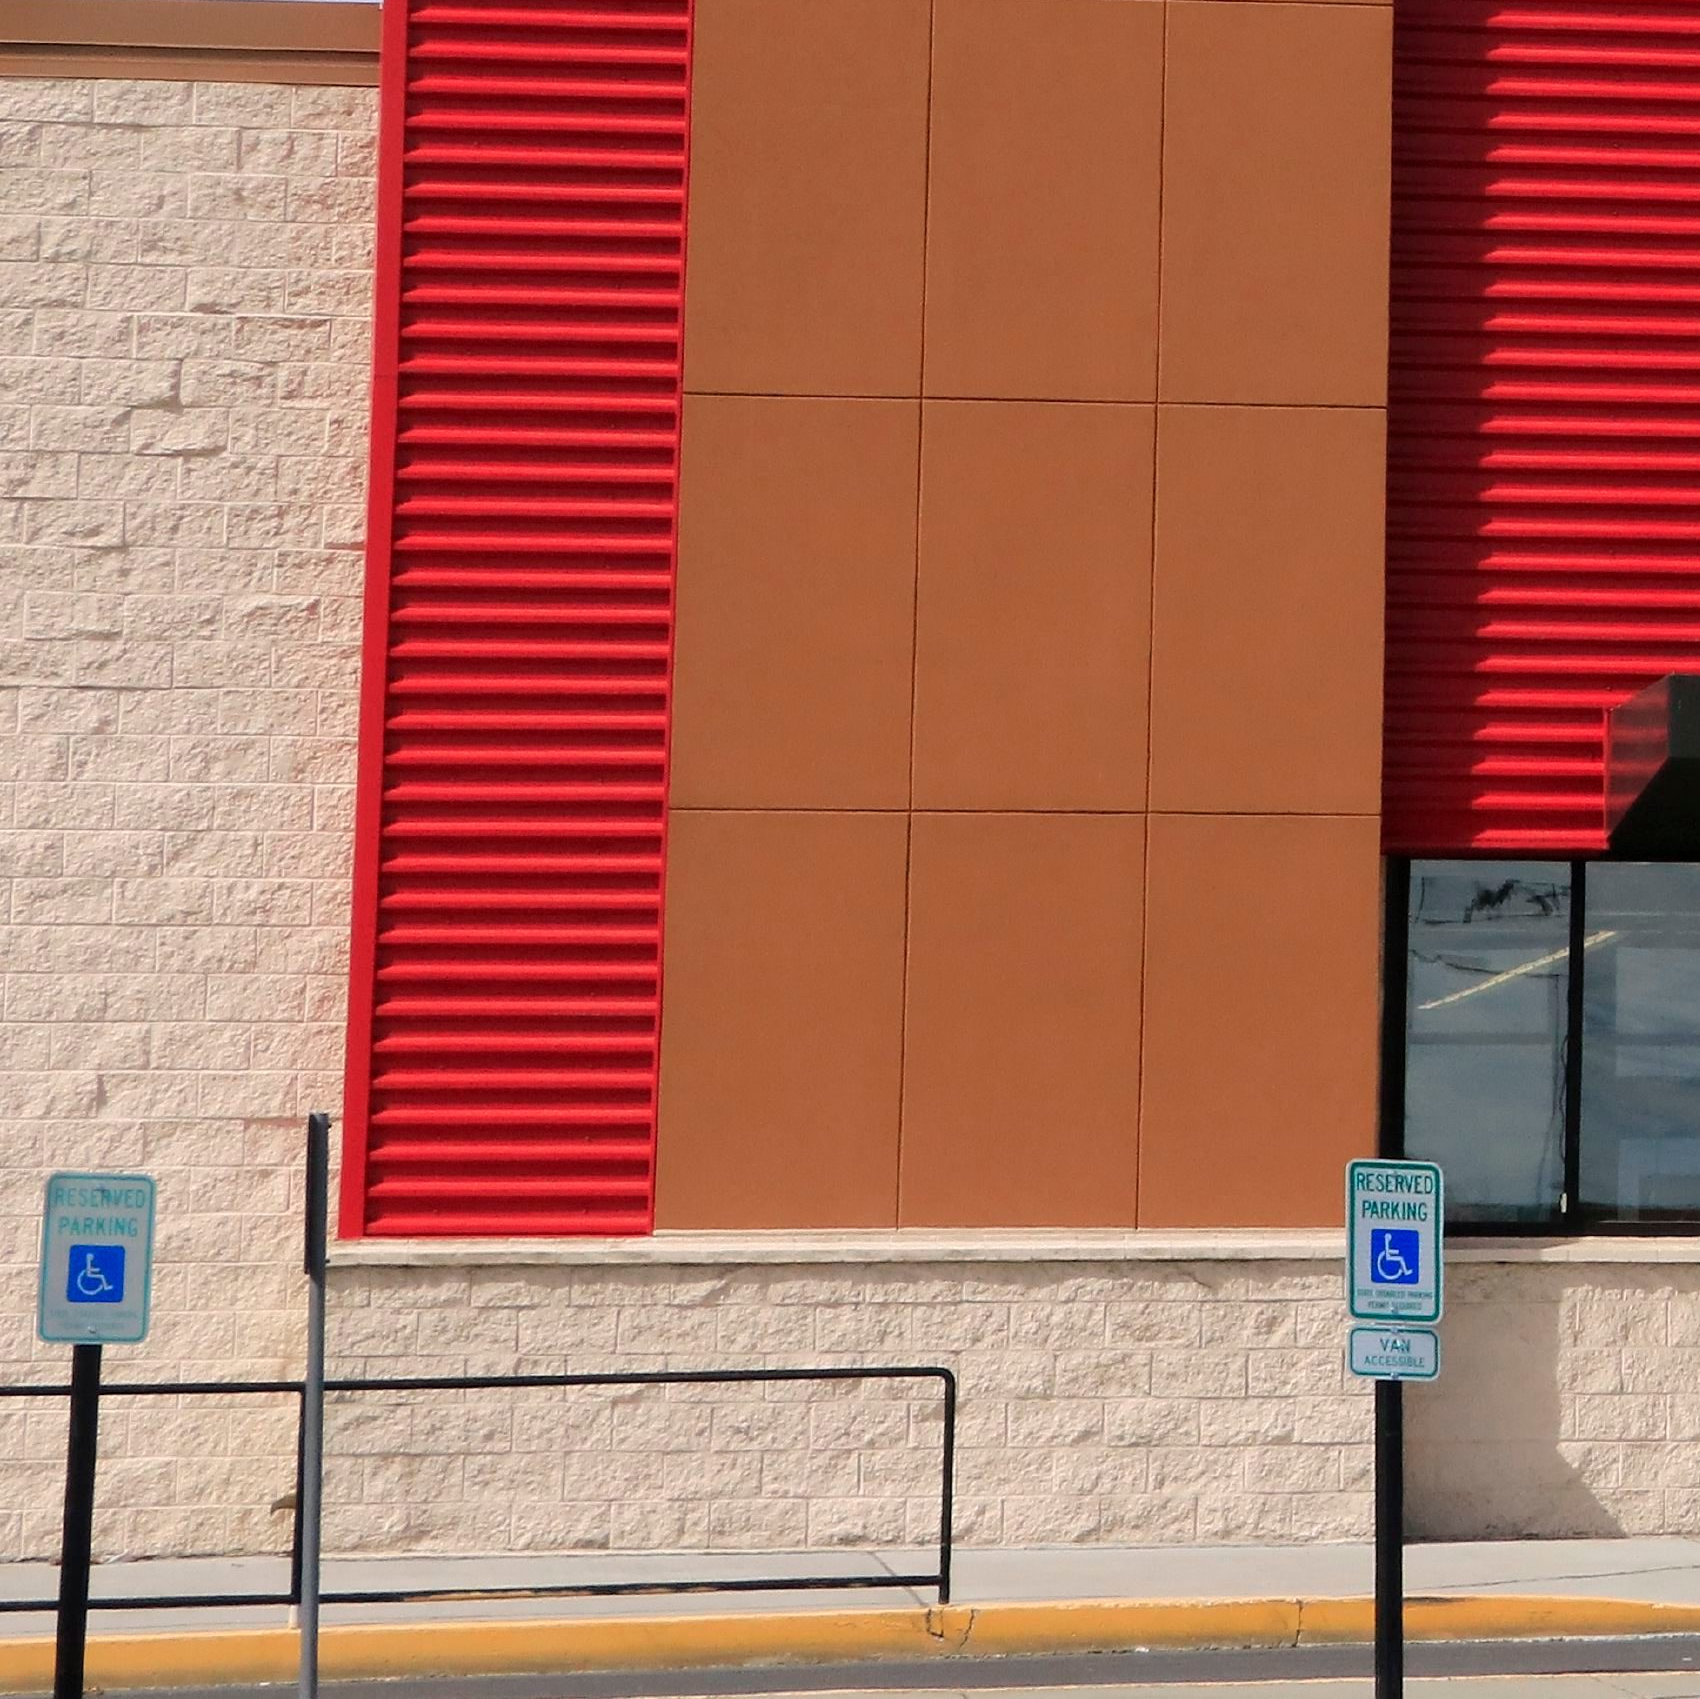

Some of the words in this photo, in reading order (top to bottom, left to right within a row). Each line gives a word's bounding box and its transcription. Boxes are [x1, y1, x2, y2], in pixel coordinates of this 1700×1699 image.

[1356, 1173, 1433, 1194] RESERVED
[54, 1188, 146, 1208] RESERVED
[1362, 1200, 1427, 1221] PARKING
[57, 1217, 138, 1237] PARKING
[1380, 1339, 1410, 1352] VAN
[1364, 1355, 1424, 1367] ACCESSIBLE
